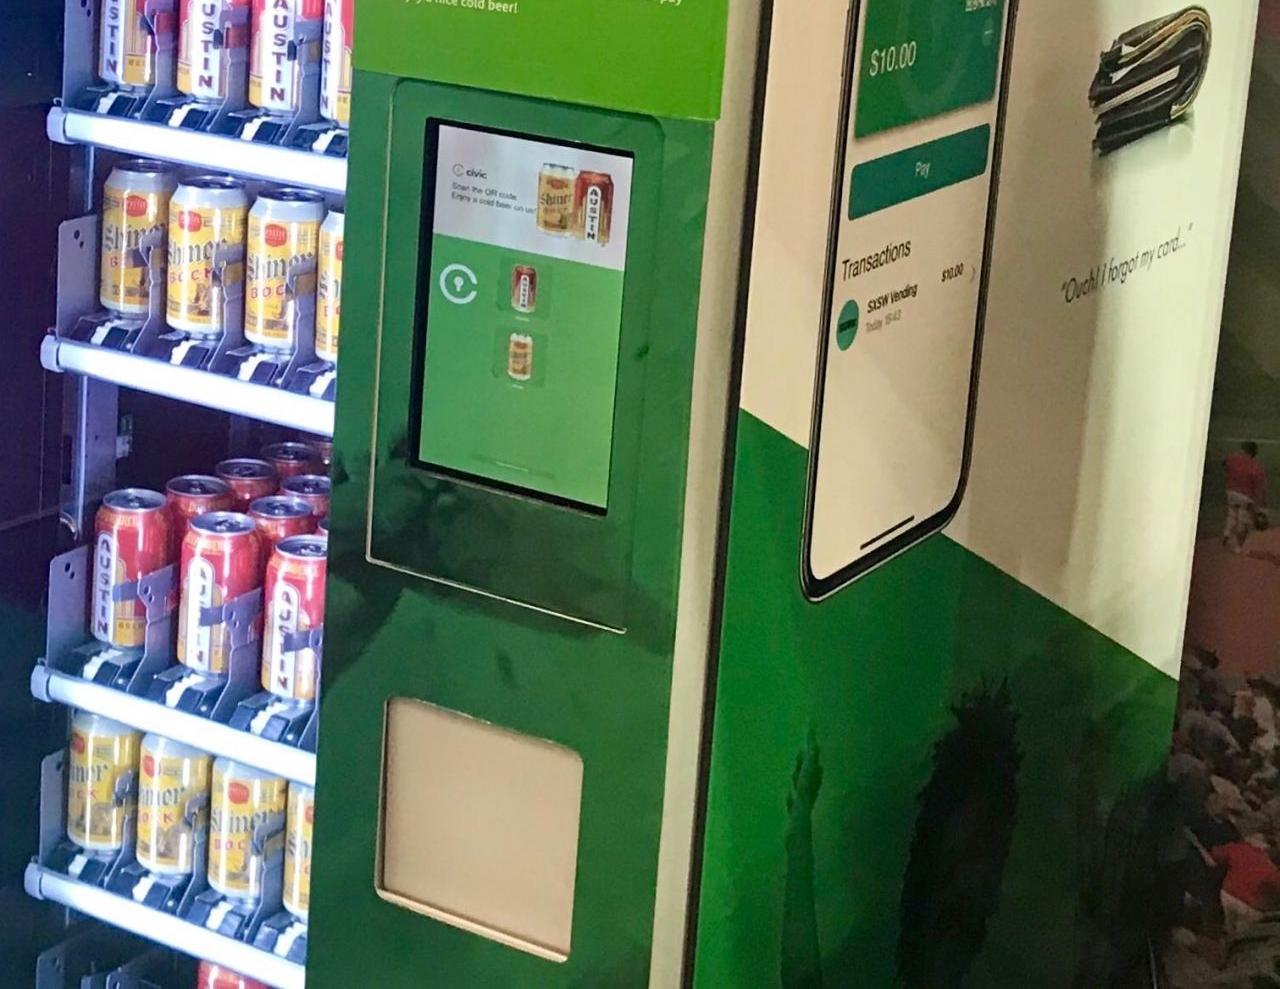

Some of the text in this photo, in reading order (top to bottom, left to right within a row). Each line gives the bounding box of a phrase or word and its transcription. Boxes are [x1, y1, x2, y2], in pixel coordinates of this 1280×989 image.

[488, 0, 518, 14] beer!
[321, 3, 333, 110] AUSTIN
[870, 40, 917, 77] $10.00
[466, 167, 487, 179] civic
[915, 161, 931, 179] Pay
[587, 188, 601, 240] AUSTIN
[842, 240, 911, 281] Transactions
[1107, 251, 1139, 284] forgot
[1140, 248, 1156, 271] my
[867, 263, 964, 314] SXSW Vending $10.00
[98, 538, 111, 635] AUSTIN
